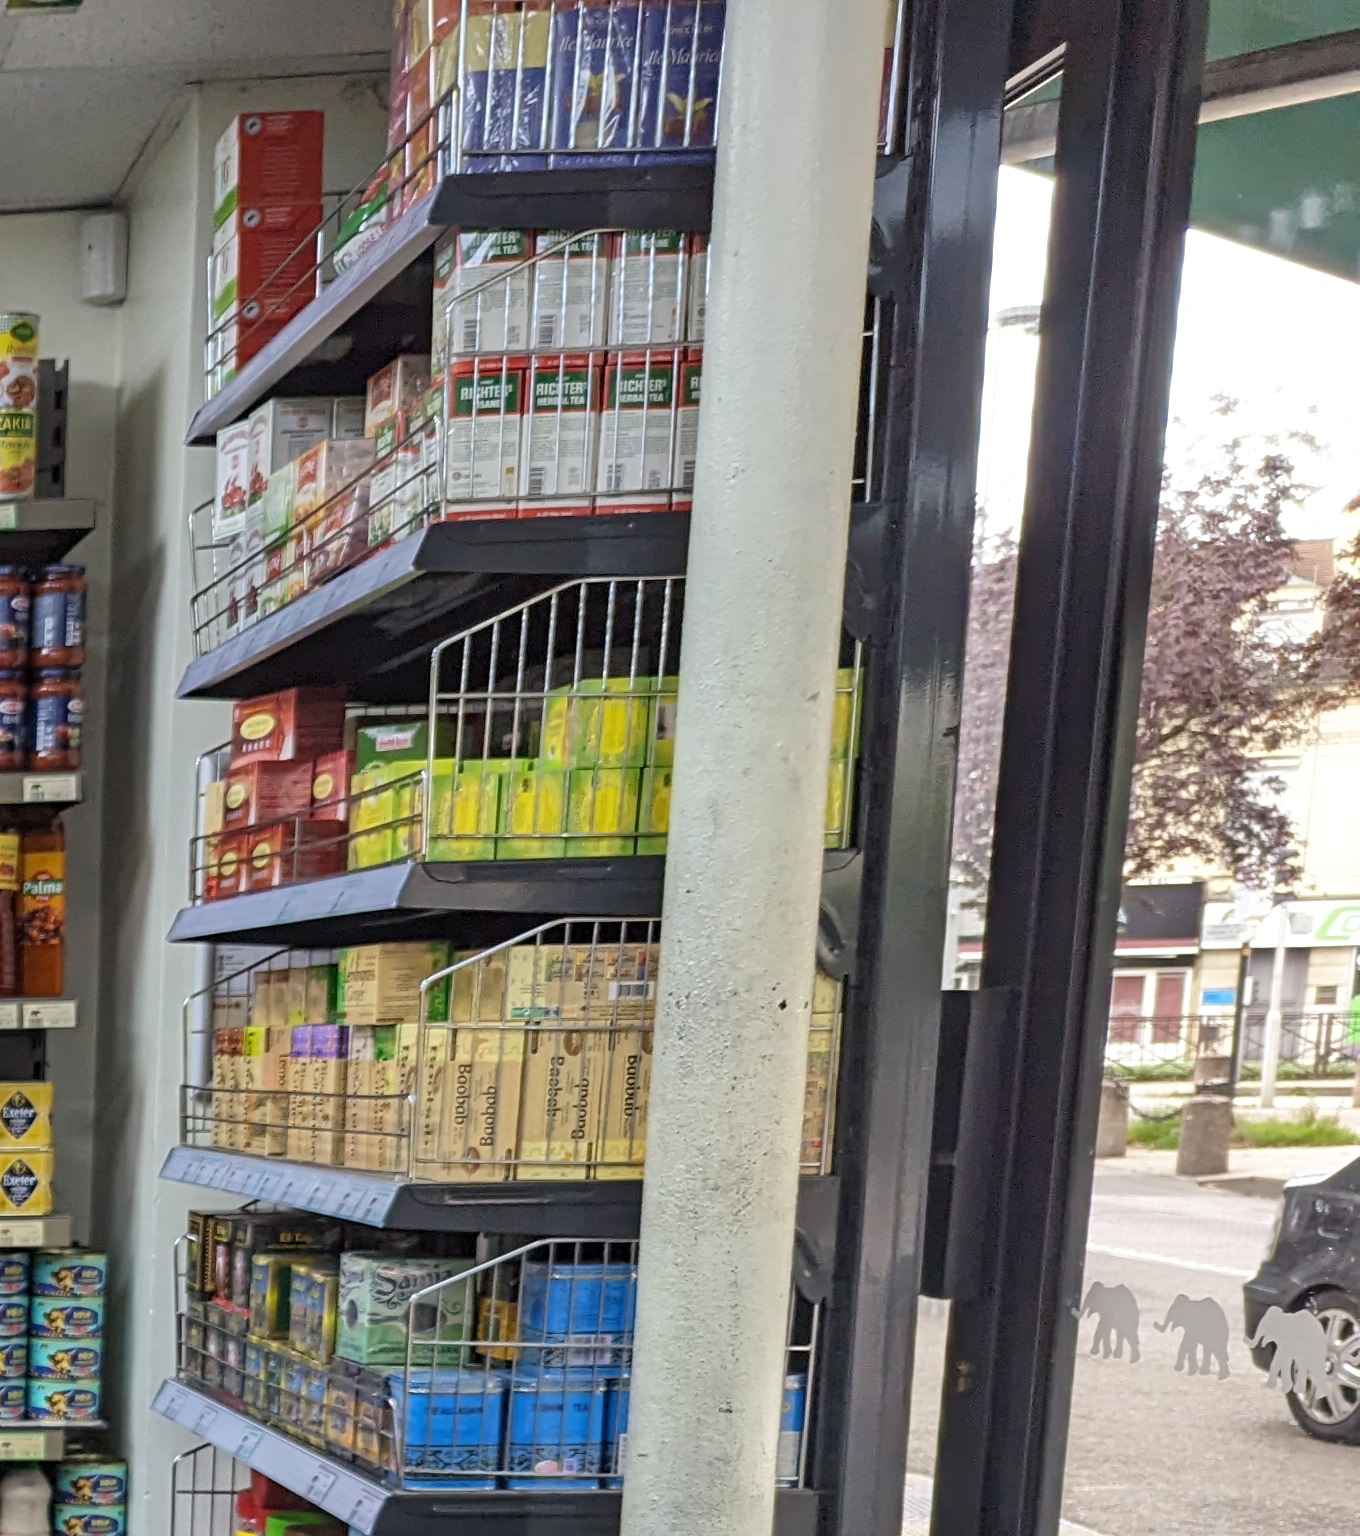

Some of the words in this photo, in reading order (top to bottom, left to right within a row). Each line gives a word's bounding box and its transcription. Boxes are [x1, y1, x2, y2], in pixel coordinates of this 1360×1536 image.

[3, 1106, 35, 1118] Exeter
[454, 1064, 472, 1126] Baobab
[479, 1084, 497, 1147] Baobab
[547, 1056, 564, 1117] Baobab
[570, 1076, 590, 1140] Baobab
[624, 1054, 639, 1117] Baobab
[2, 1175, 36, 1186] Exeter
